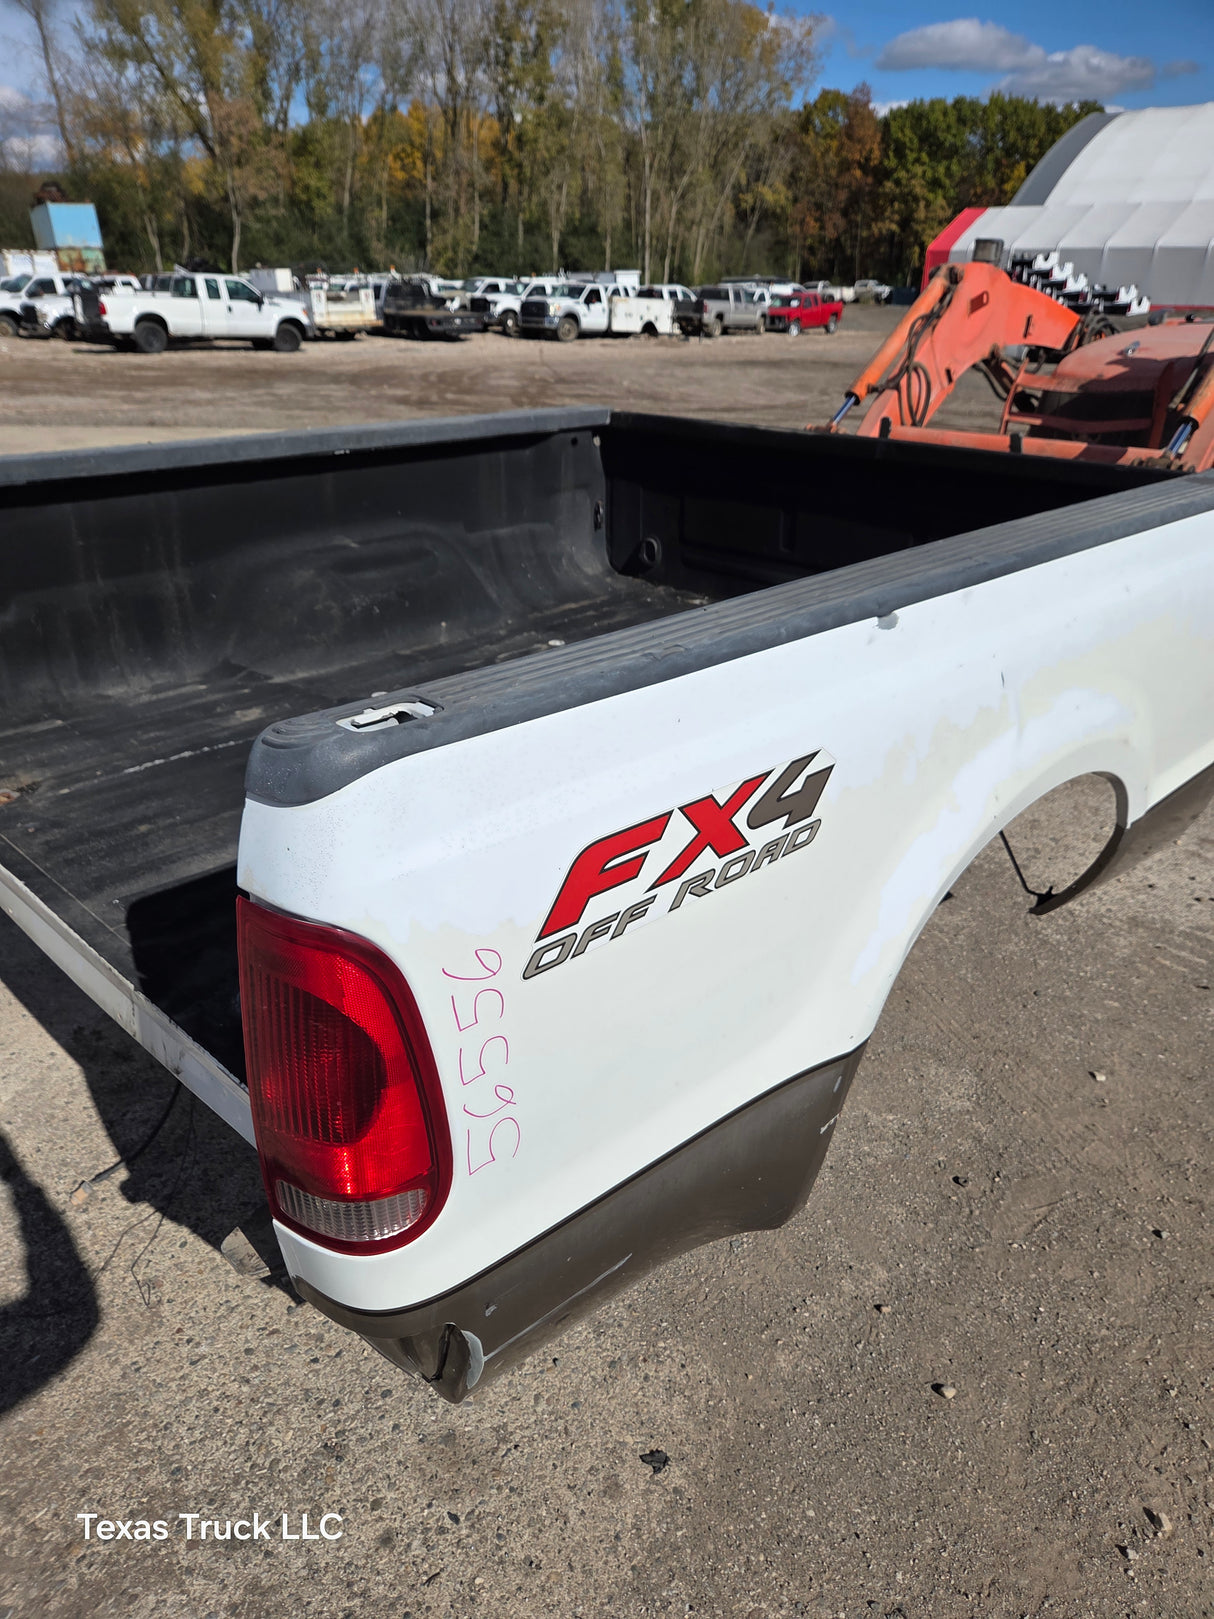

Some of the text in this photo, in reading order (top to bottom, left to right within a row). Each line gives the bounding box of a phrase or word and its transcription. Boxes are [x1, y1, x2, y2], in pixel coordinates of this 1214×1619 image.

[521, 817, 822, 981] OFF ROAD
[534, 748, 836, 942] FX4
[441, 947, 521, 1176] 56556
